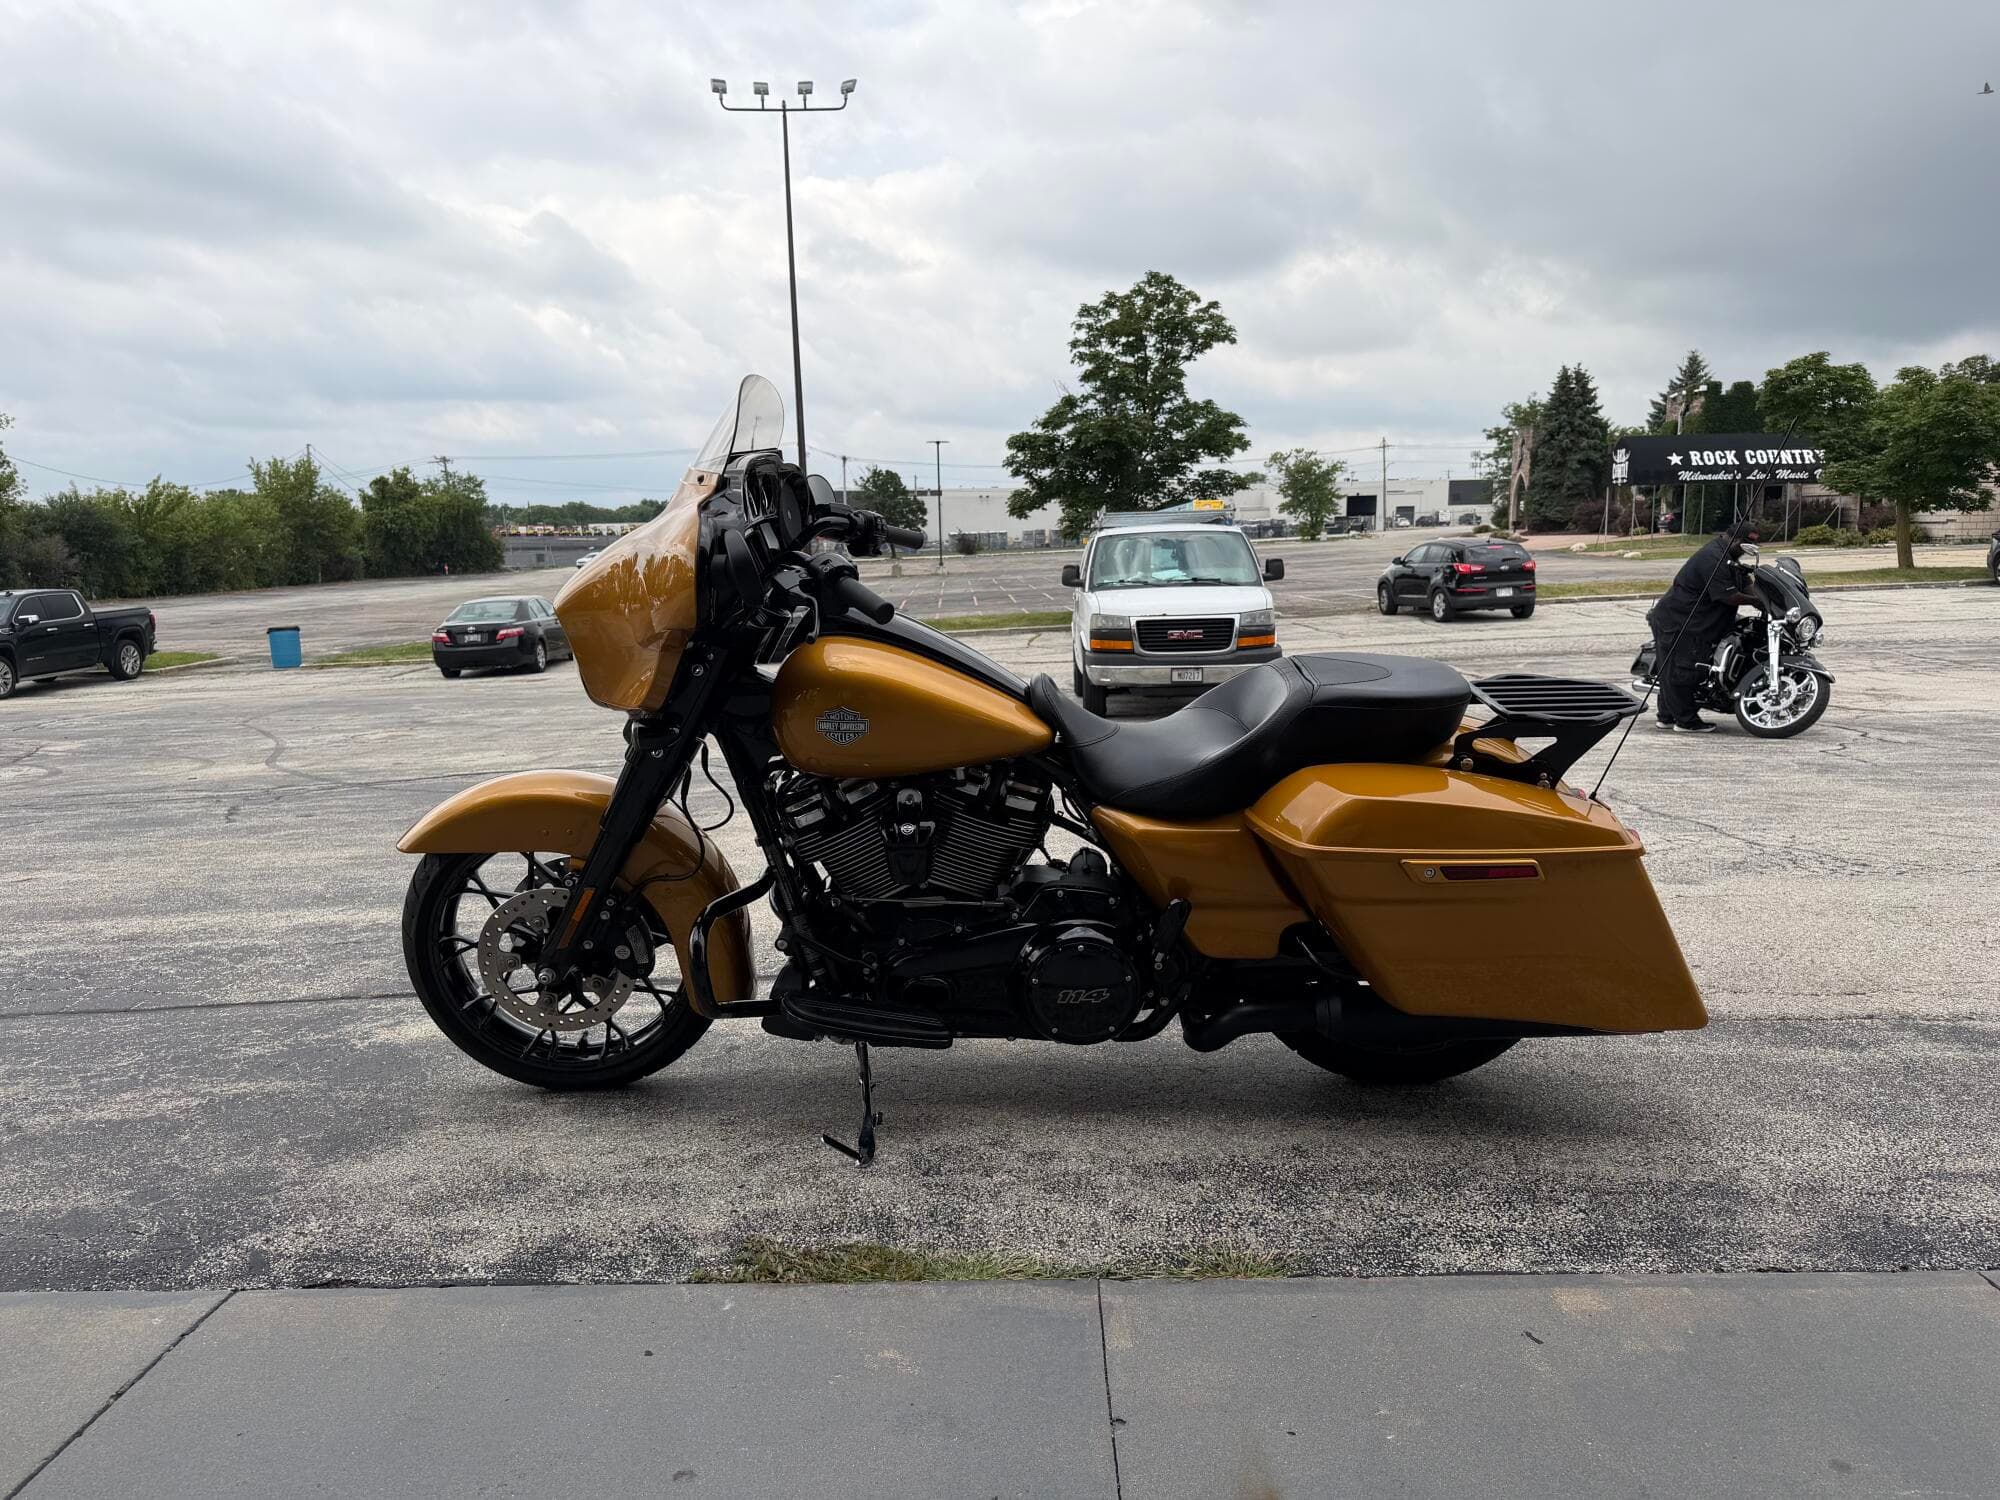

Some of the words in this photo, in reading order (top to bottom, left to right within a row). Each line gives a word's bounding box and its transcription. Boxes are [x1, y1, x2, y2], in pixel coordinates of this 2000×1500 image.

[1690, 450, 1739, 466] ROCK
[1677, 469, 1742, 481] Milwaukee's
[1775, 468, 1809, 480] Music
[1167, 629, 1204, 641] GMC
[819, 721, 866, 731] HARLEY-DAVIDSON
[1056, 988, 1111, 1004] 114
